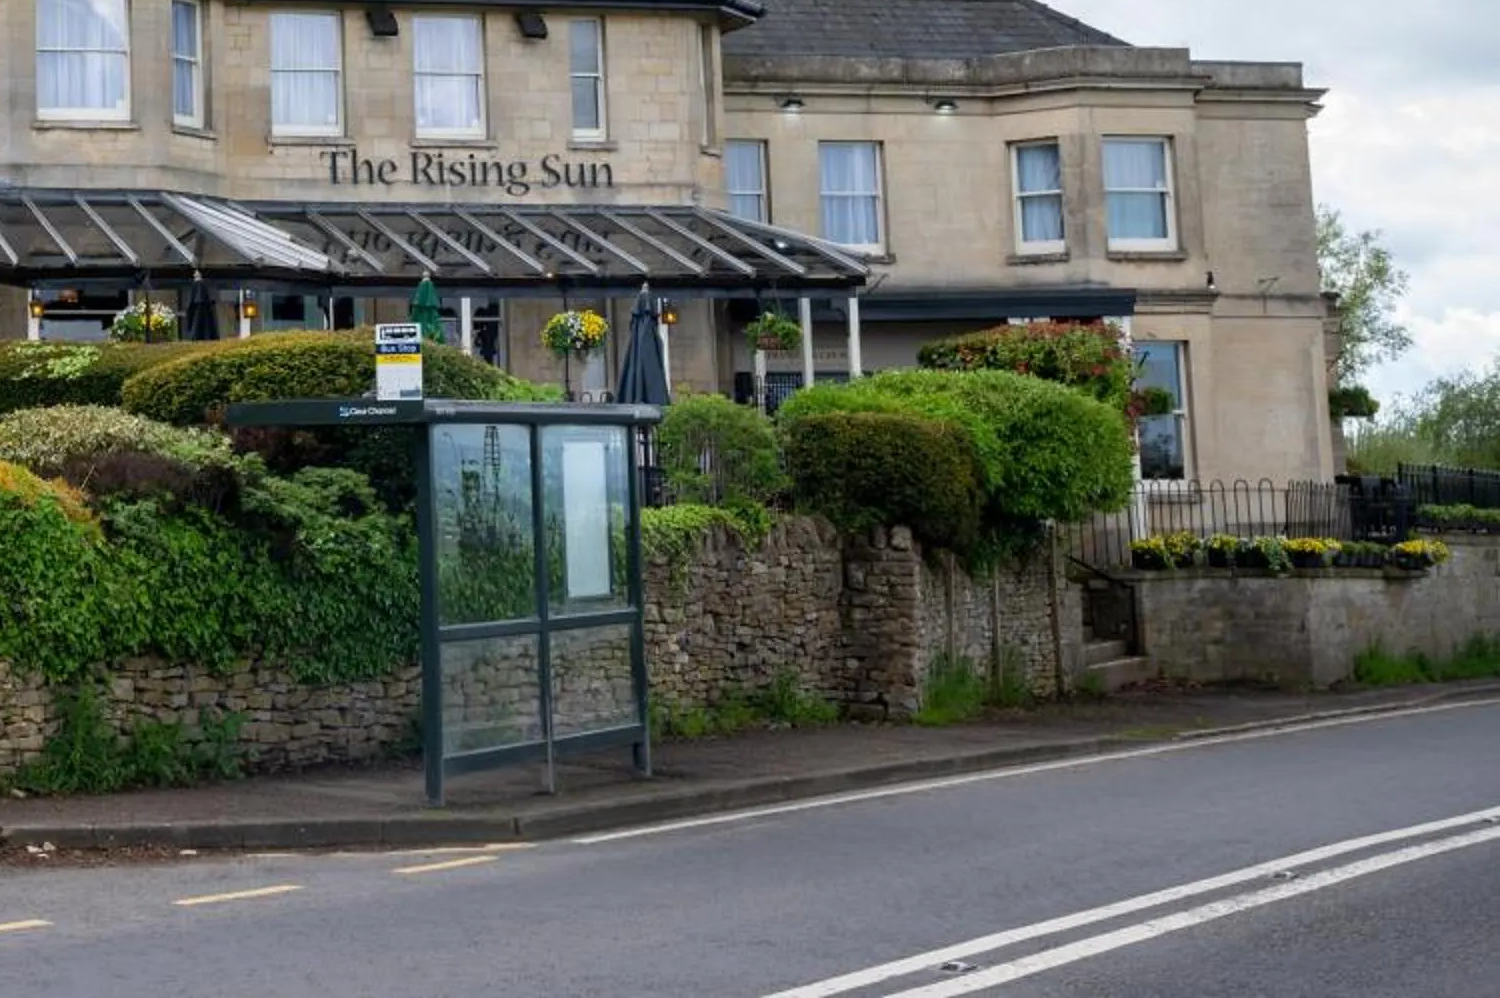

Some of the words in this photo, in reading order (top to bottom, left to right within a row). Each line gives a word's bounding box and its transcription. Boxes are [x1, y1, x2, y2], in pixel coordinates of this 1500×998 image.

[320, 149, 398, 186] The
[409, 151, 531, 197] Rising
[539, 153, 614, 188] Sun
